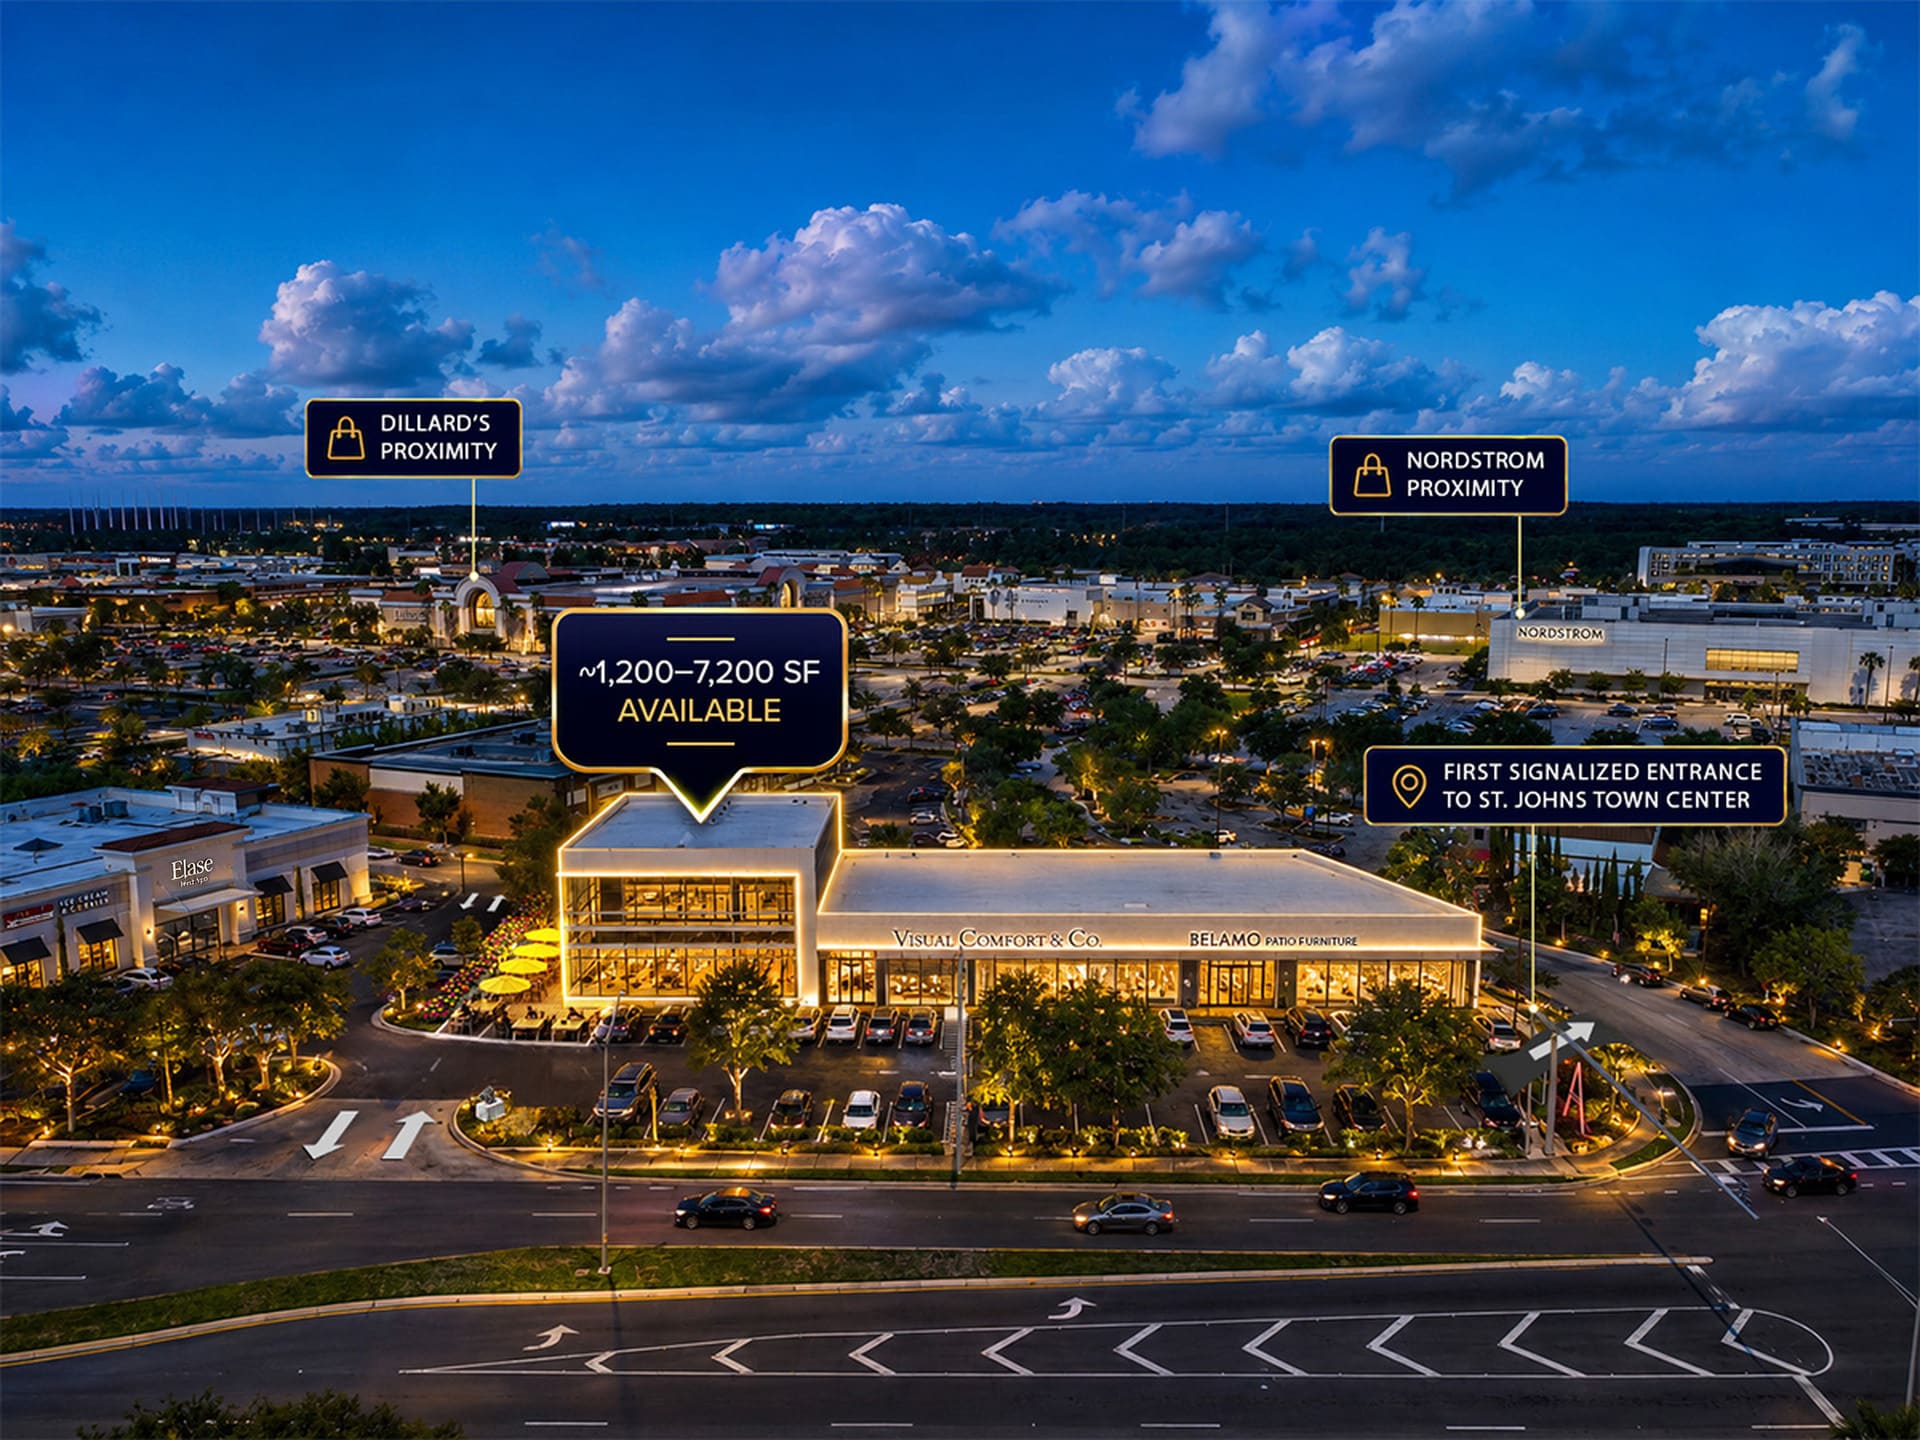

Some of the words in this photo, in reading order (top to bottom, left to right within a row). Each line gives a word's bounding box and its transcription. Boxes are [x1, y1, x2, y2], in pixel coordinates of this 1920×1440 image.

[1518, 626, 1603, 640] NORDSTROM
[170, 858, 213, 881] Elase
[1050, 934, 1064, 947] &
[1190, 932, 1261, 947] BELAMO
[1265, 936, 1297, 946] PATIO
[1299, 936, 1359, 946] FURNITURE
